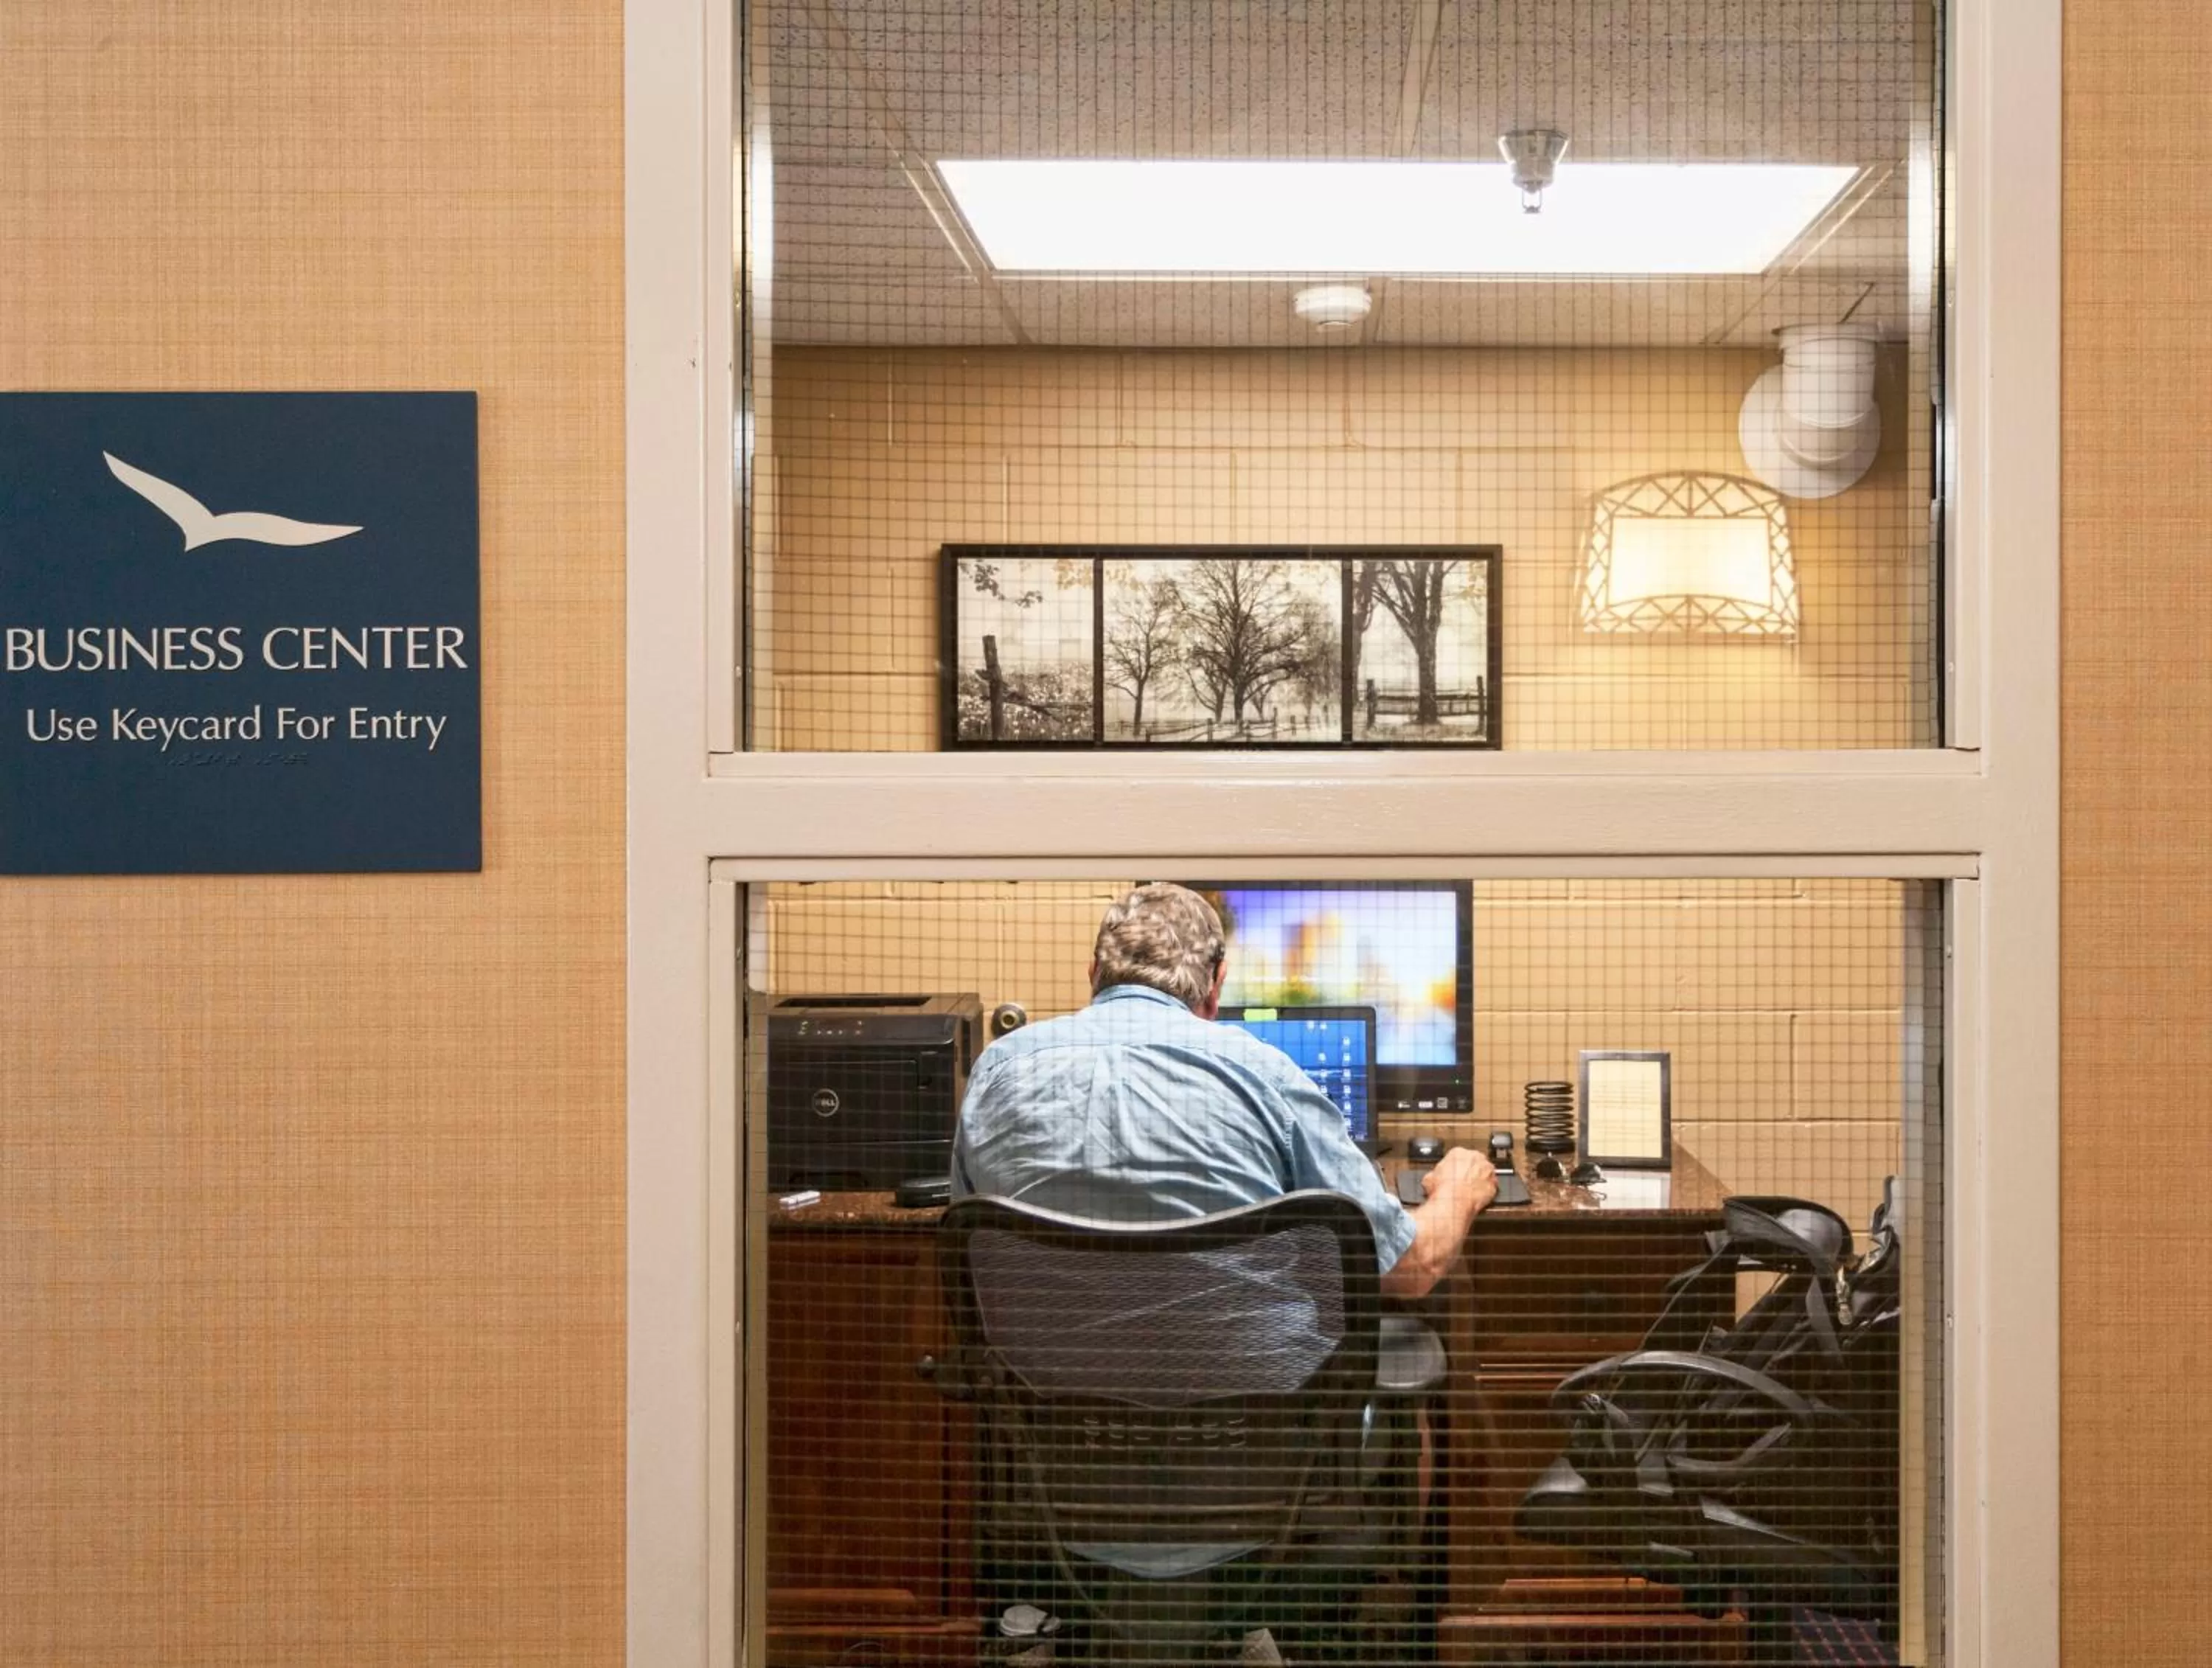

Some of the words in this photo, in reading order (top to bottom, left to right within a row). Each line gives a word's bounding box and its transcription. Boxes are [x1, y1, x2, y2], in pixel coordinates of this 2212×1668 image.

[7, 627, 243, 670] BUSINESS
[262, 627, 468, 670] CENTER
[27, 709, 97, 741] Use
[112, 705, 260, 751] Keycard
[277, 707, 335, 740] For
[349, 707, 447, 751] Entry
